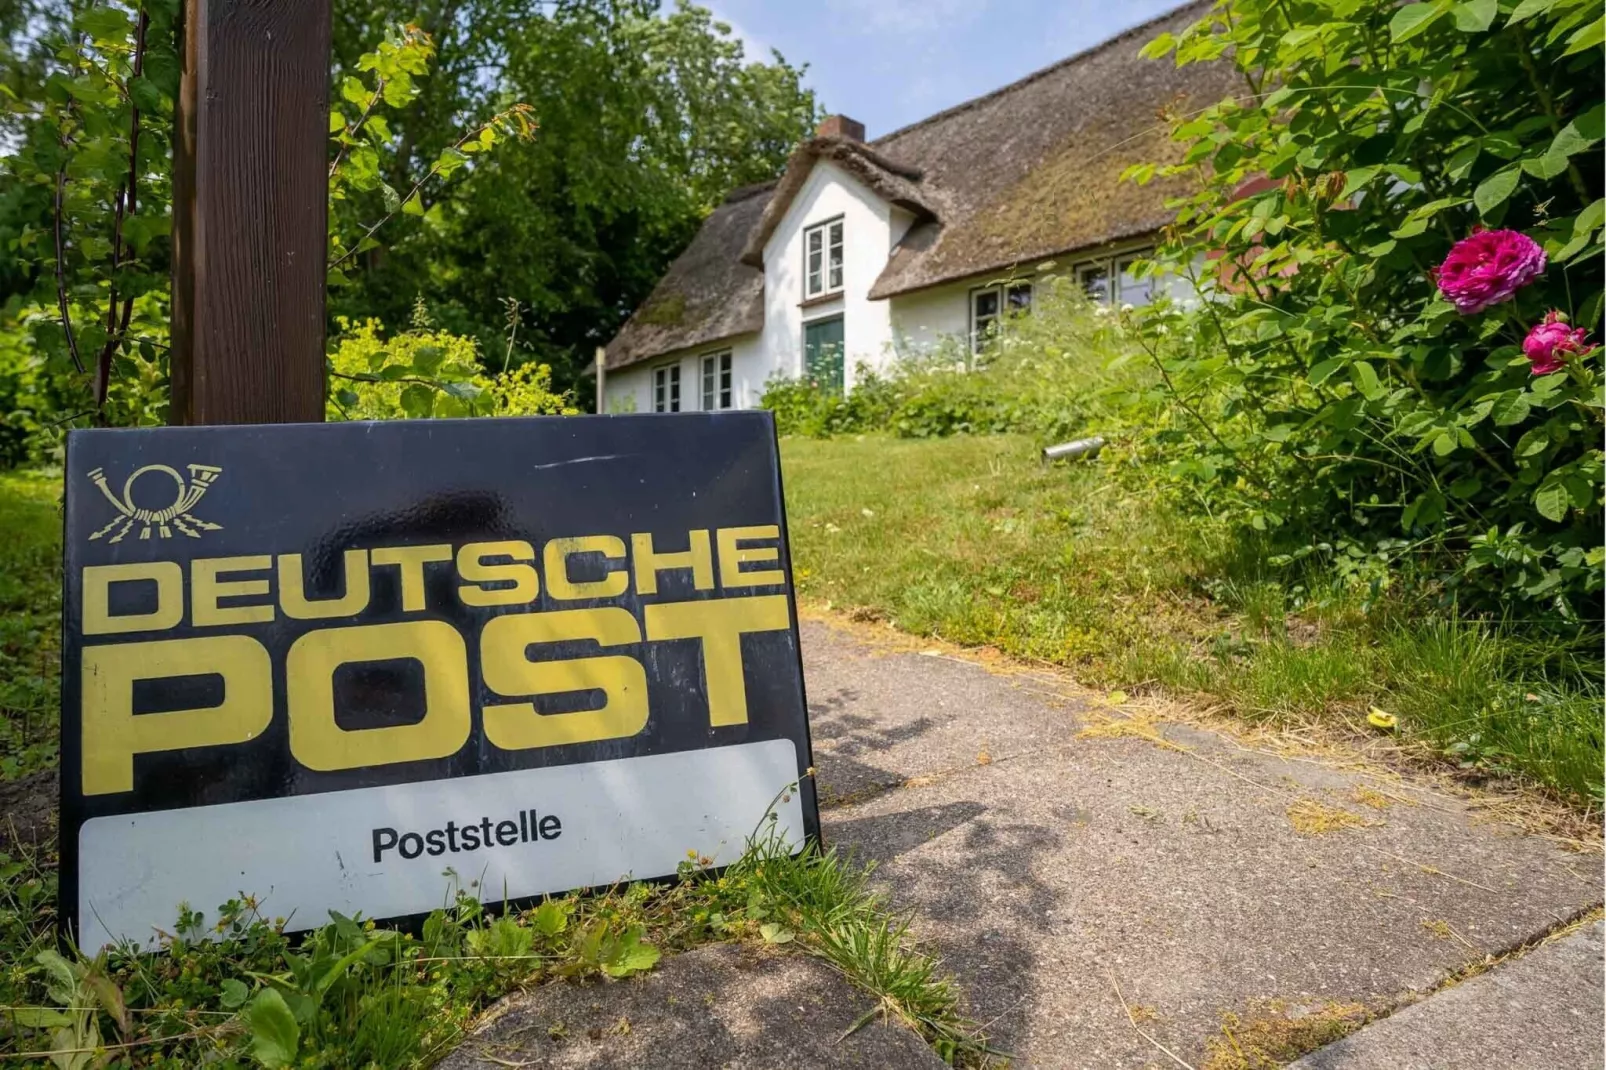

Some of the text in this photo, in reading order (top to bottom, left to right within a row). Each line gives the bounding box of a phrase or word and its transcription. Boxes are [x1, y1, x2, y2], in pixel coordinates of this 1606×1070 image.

[81, 525, 786, 635] DEUTSCHE
[80, 594, 791, 796] POST
[372, 808, 562, 864] Poststelle
